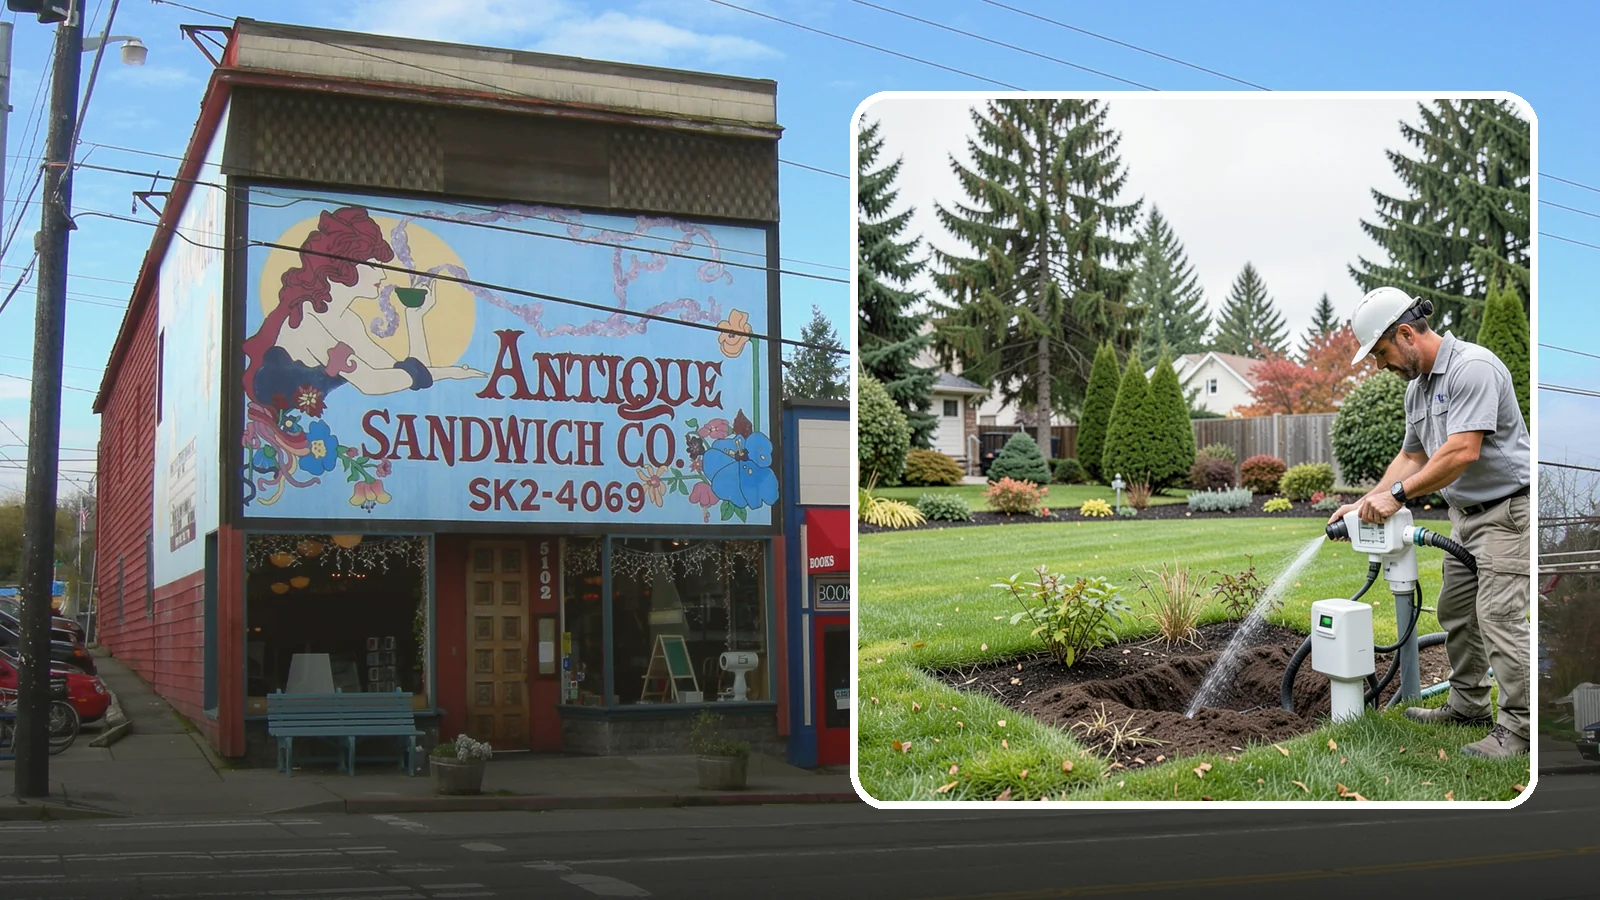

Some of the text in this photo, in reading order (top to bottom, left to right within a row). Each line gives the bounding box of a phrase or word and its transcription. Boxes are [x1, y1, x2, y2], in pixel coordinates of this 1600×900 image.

[476, 329, 723, 420] ANTIQUE
[361, 408, 684, 468] SANDWICH CO.
[468, 477, 646, 512] SK2-4069
[540, 541, 551, 600] 5102
[809, 555, 835, 569] BOOKS
